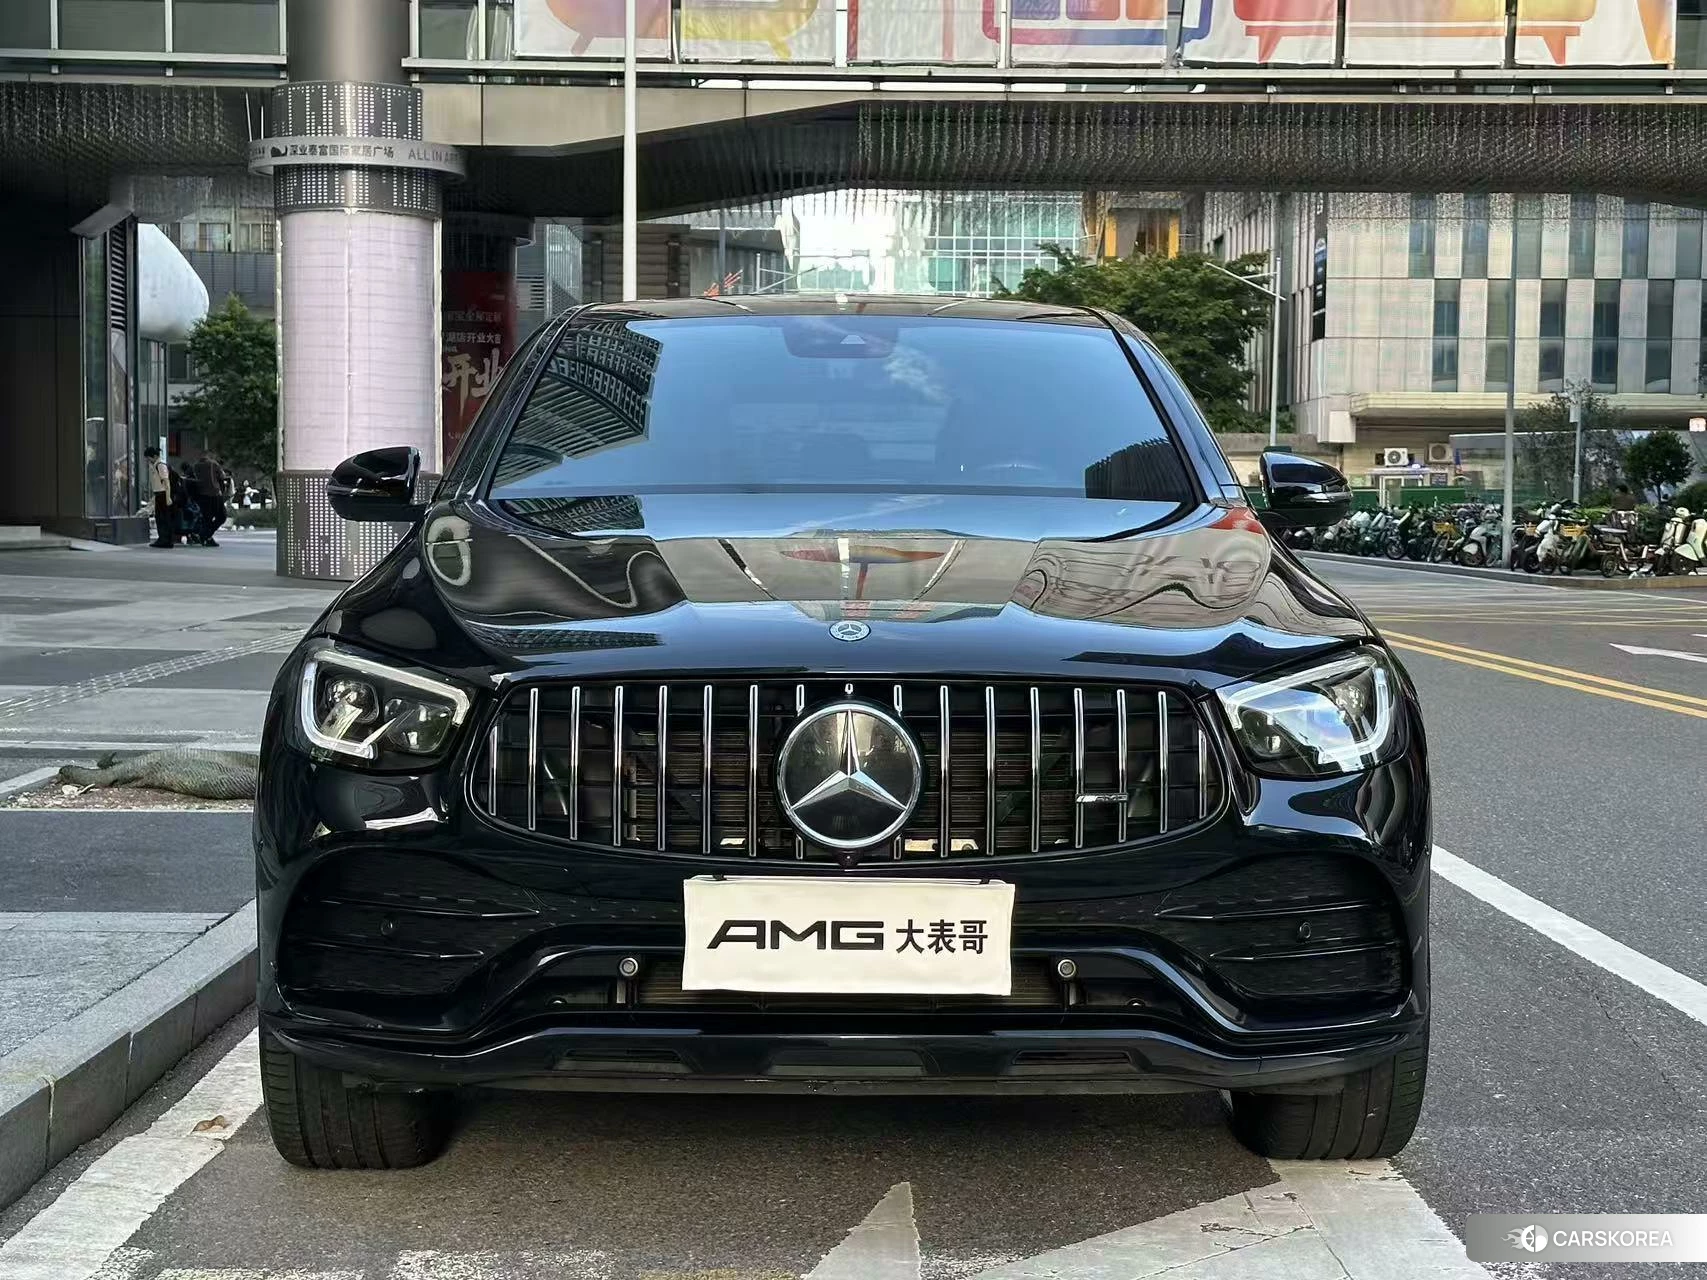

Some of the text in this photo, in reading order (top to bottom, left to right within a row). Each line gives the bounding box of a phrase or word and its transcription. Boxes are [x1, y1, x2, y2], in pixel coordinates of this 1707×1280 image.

[289, 144, 394, 158] 深业泰富国际家居广场
[408, 147, 429, 161] ALL
[706, 918, 988, 954] AMG 大表哥
